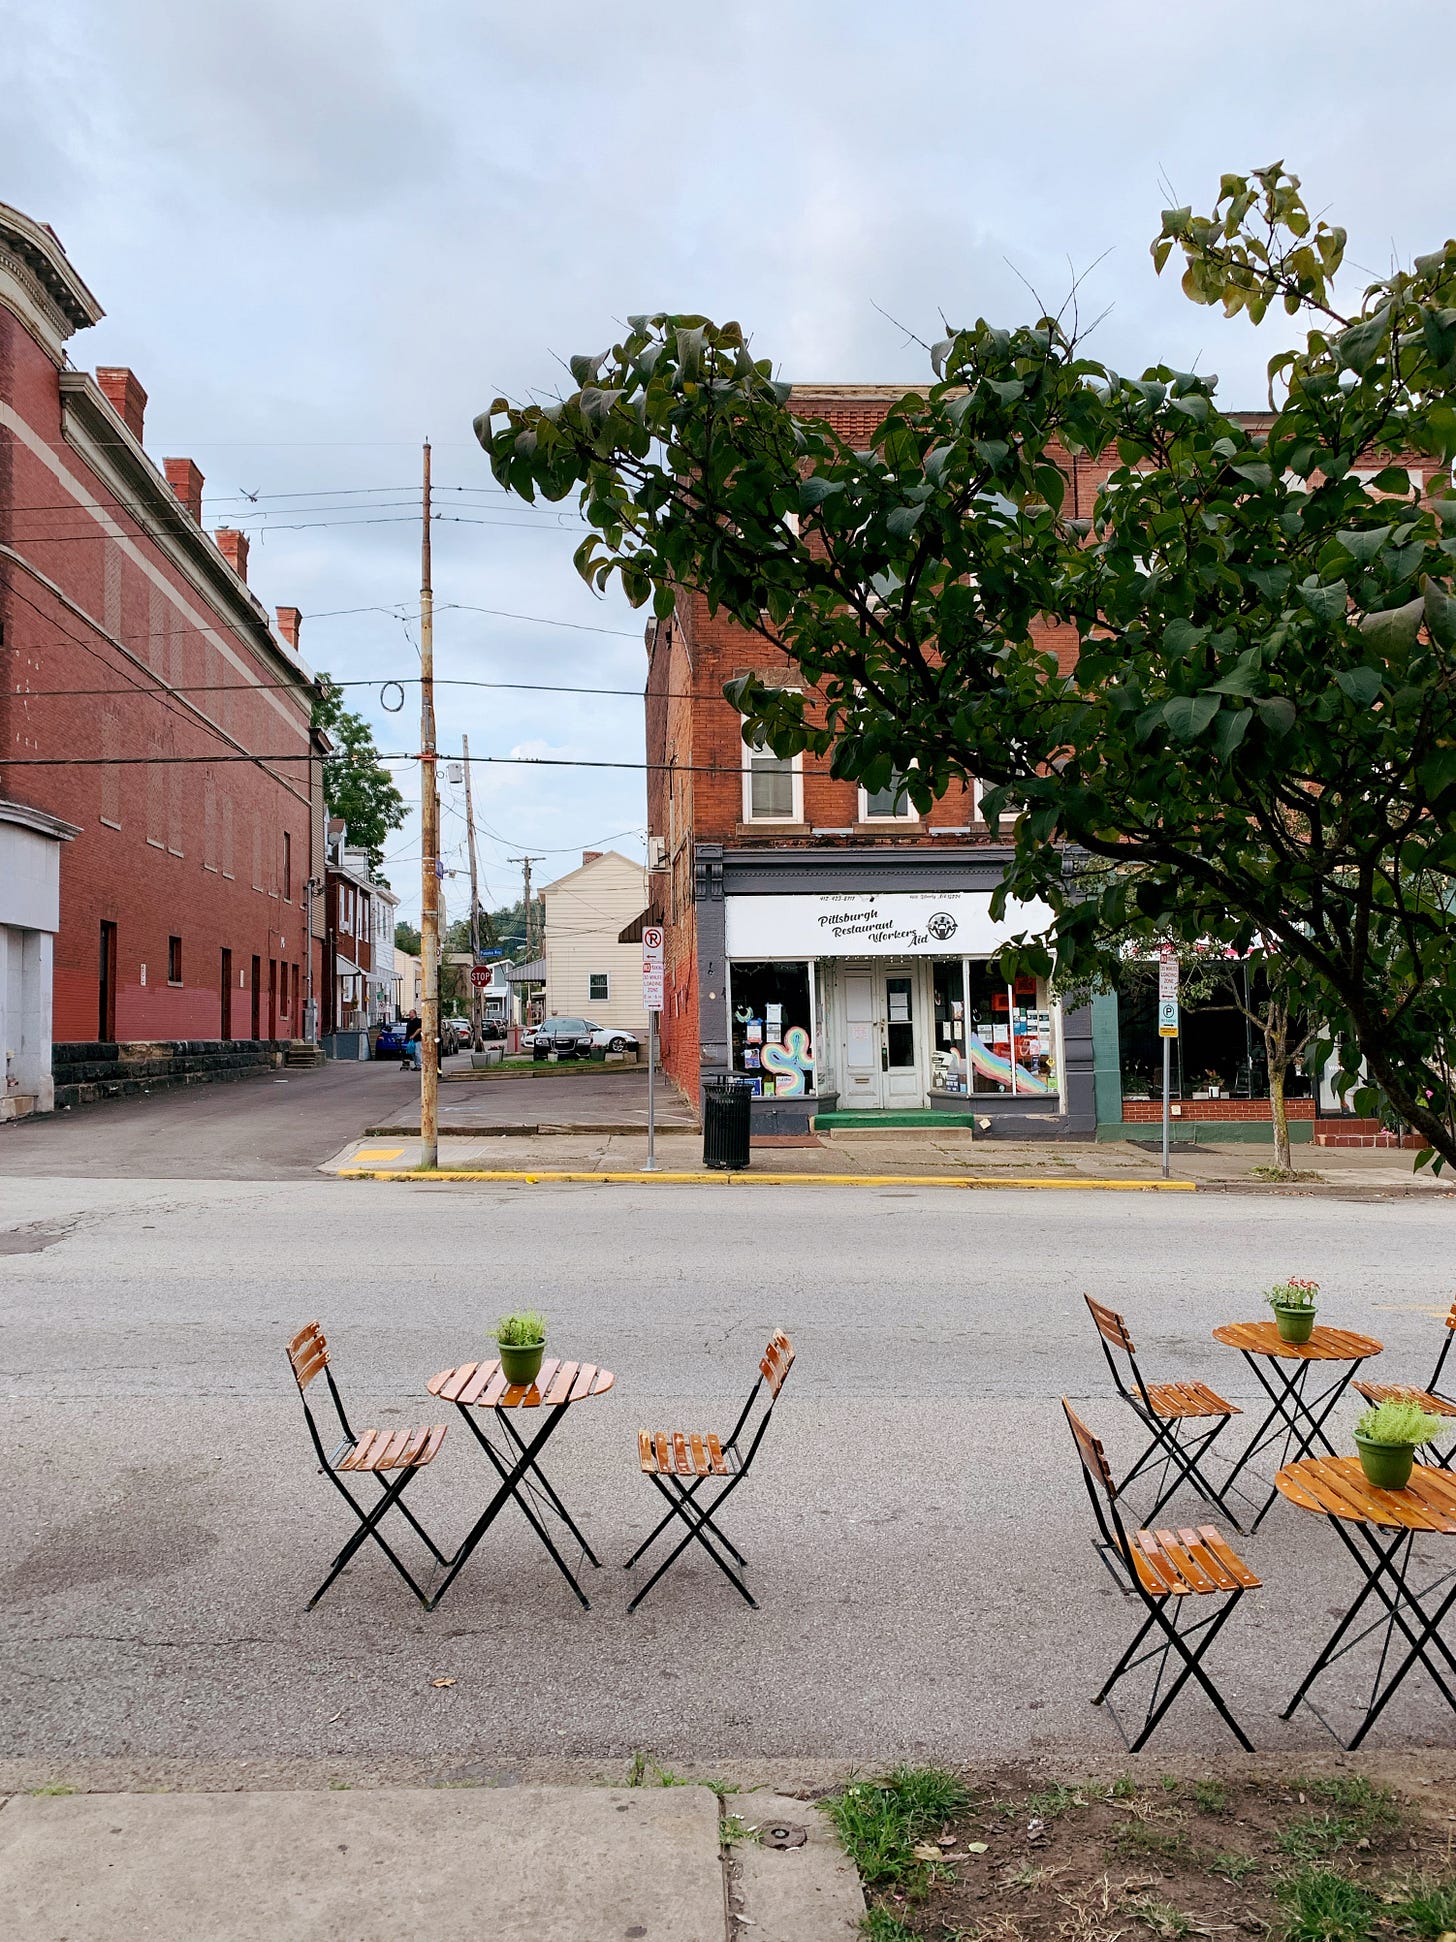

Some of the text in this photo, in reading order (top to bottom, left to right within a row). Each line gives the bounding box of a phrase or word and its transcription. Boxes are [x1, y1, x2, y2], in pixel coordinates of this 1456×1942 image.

[818, 909, 878, 927] Pittsburgh
[832, 919, 893, 938] Restaurant
[868, 929, 917, 943] Workers
[907, 934, 929, 948] Aid
[471, 972, 490, 981] STOP
